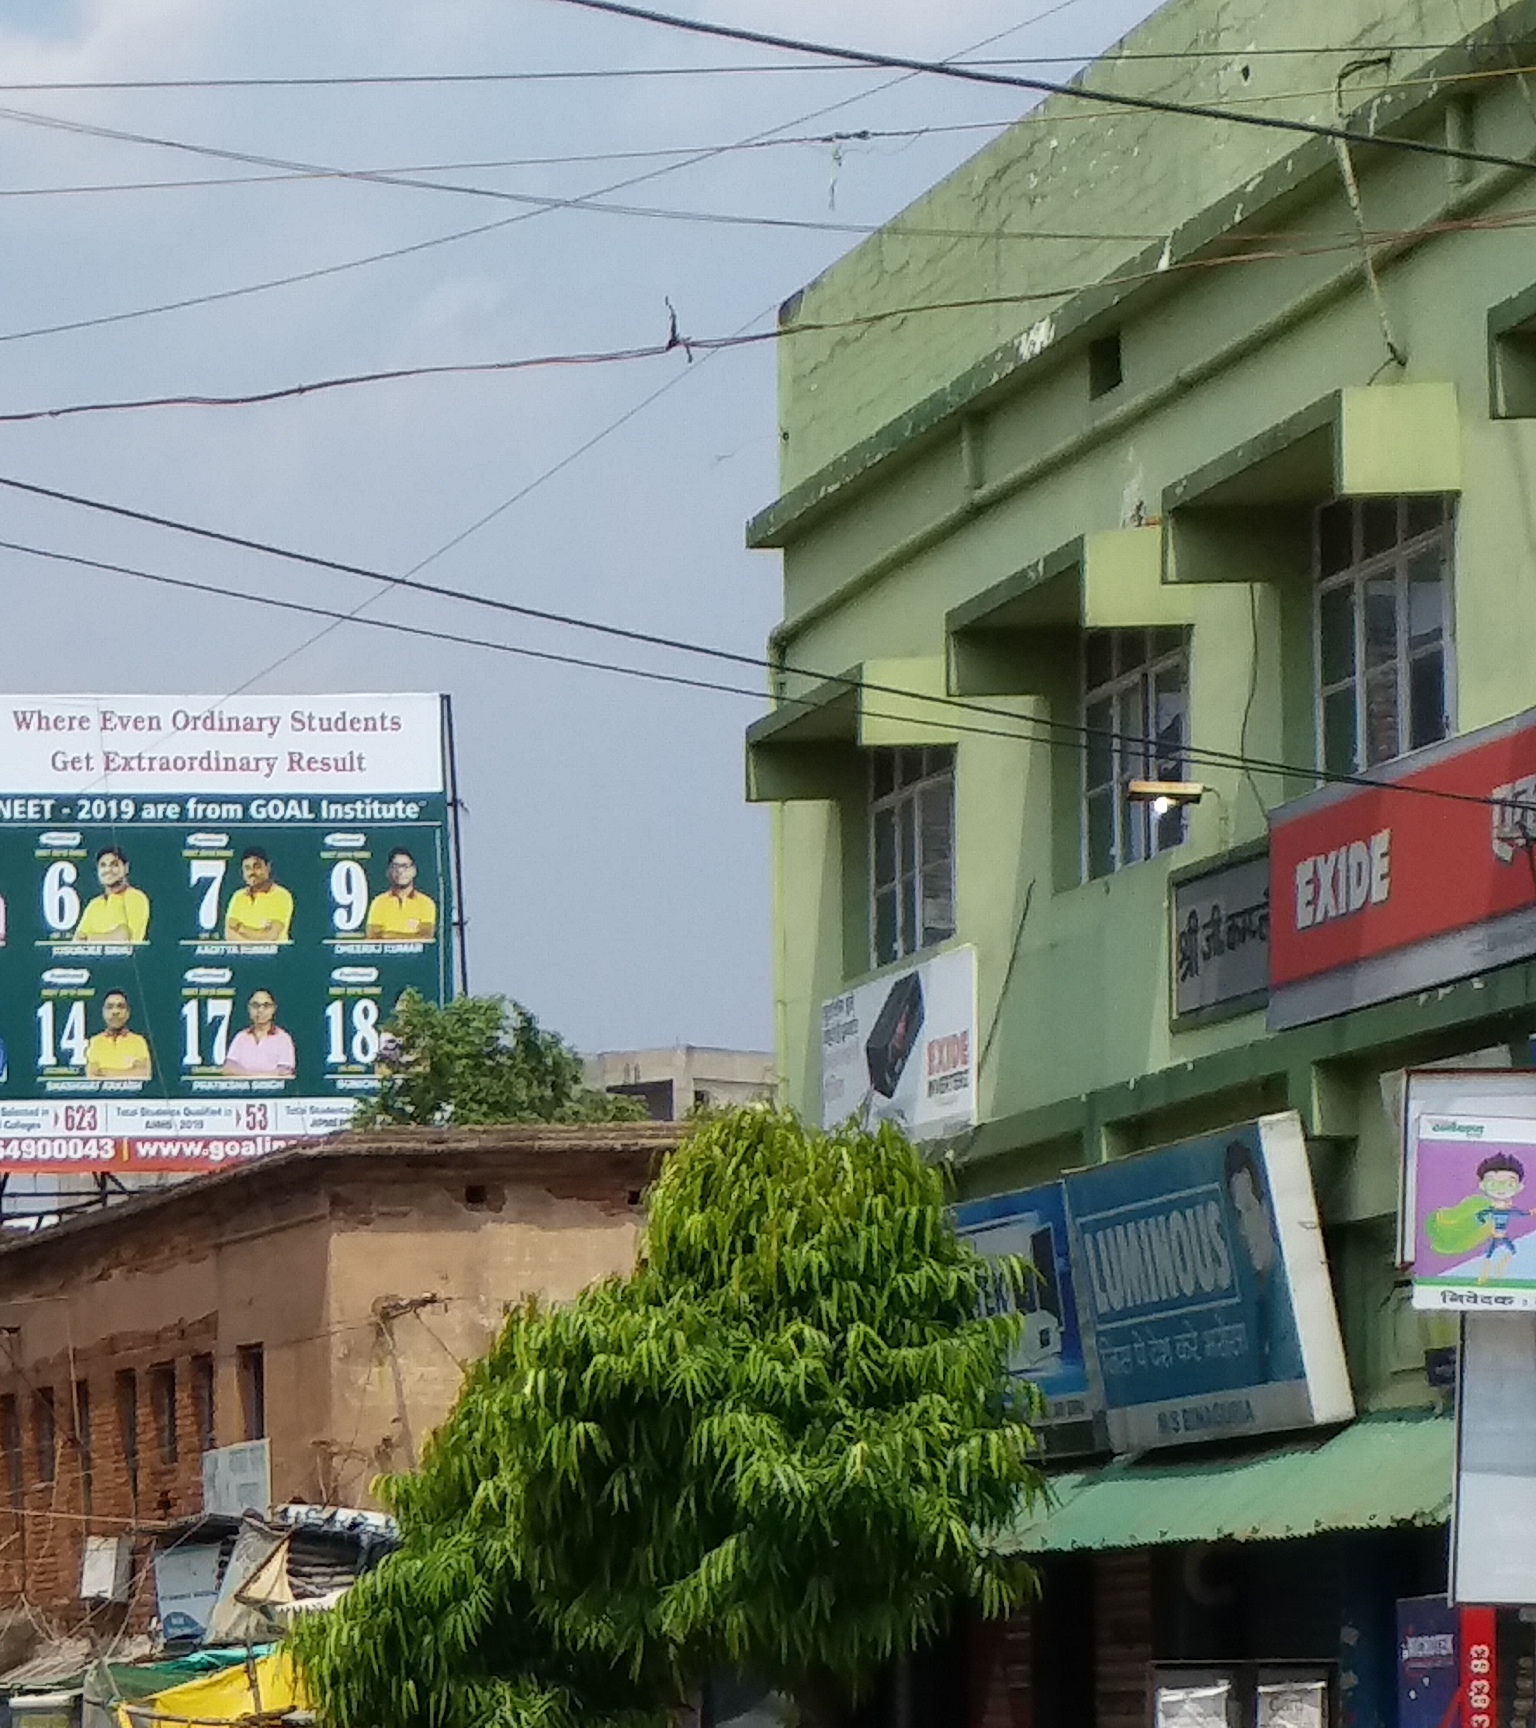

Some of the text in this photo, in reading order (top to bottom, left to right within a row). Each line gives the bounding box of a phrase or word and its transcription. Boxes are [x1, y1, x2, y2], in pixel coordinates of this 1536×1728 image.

[12, 709, 403, 738] Where Even Ordinary Students
[51, 751, 367, 778] Get Extraordinary Result
[77, 800, 134, 821] 2019
[141, 804, 180, 821] are
[186, 800, 243, 821] from
[249, 800, 315, 821] GOAL
[320, 799, 420, 820] Institute
[42, 860, 80, 931] 6
[189, 859, 227, 931] 7
[330, 859, 369, 931] 9
[1295, 827, 1393, 931] EXIDE
[36, 1000, 89, 1067] 14
[181, 999, 233, 1066] 17
[325, 998, 379, 1064] 18
[927, 1029, 970, 1078] EXIDE
[64, 1106, 98, 1131] 623
[245, 1103, 269, 1131] 53
[135, 1135, 298, 1163] www.goalin
[1084, 1200, 1233, 1316] LUMINOUS
[1440, 1289, 1515, 1306] निवेदक
[1469, 1643, 1490, 1674] 83
[1470, 1679, 1491, 1709] 83
